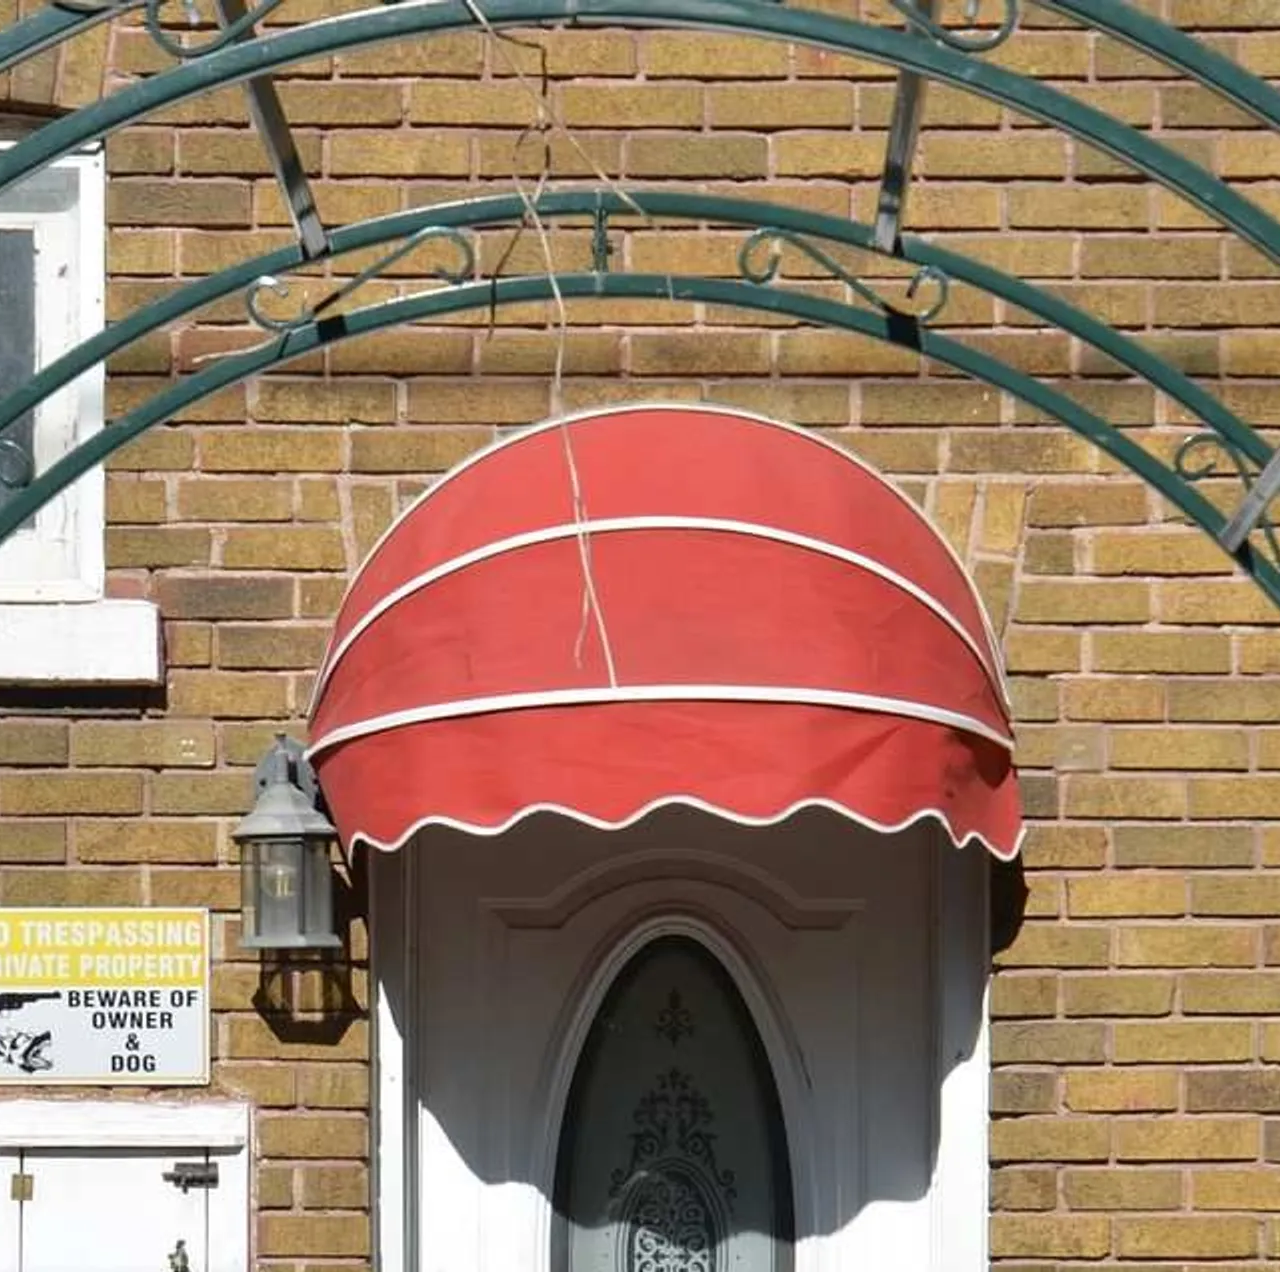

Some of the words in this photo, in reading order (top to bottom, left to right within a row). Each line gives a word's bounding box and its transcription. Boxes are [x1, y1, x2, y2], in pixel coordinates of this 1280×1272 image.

[20, 921, 201, 947] TRESPASSING
[79, 954, 201, 977] PROPERTY
[68, 990, 160, 1008] BEWARE
[170, 990, 198, 1008] OF
[92, 1012, 173, 1029] OWNER
[125, 1034, 140, 1051] &
[112, 1055, 156, 1072] DOG
